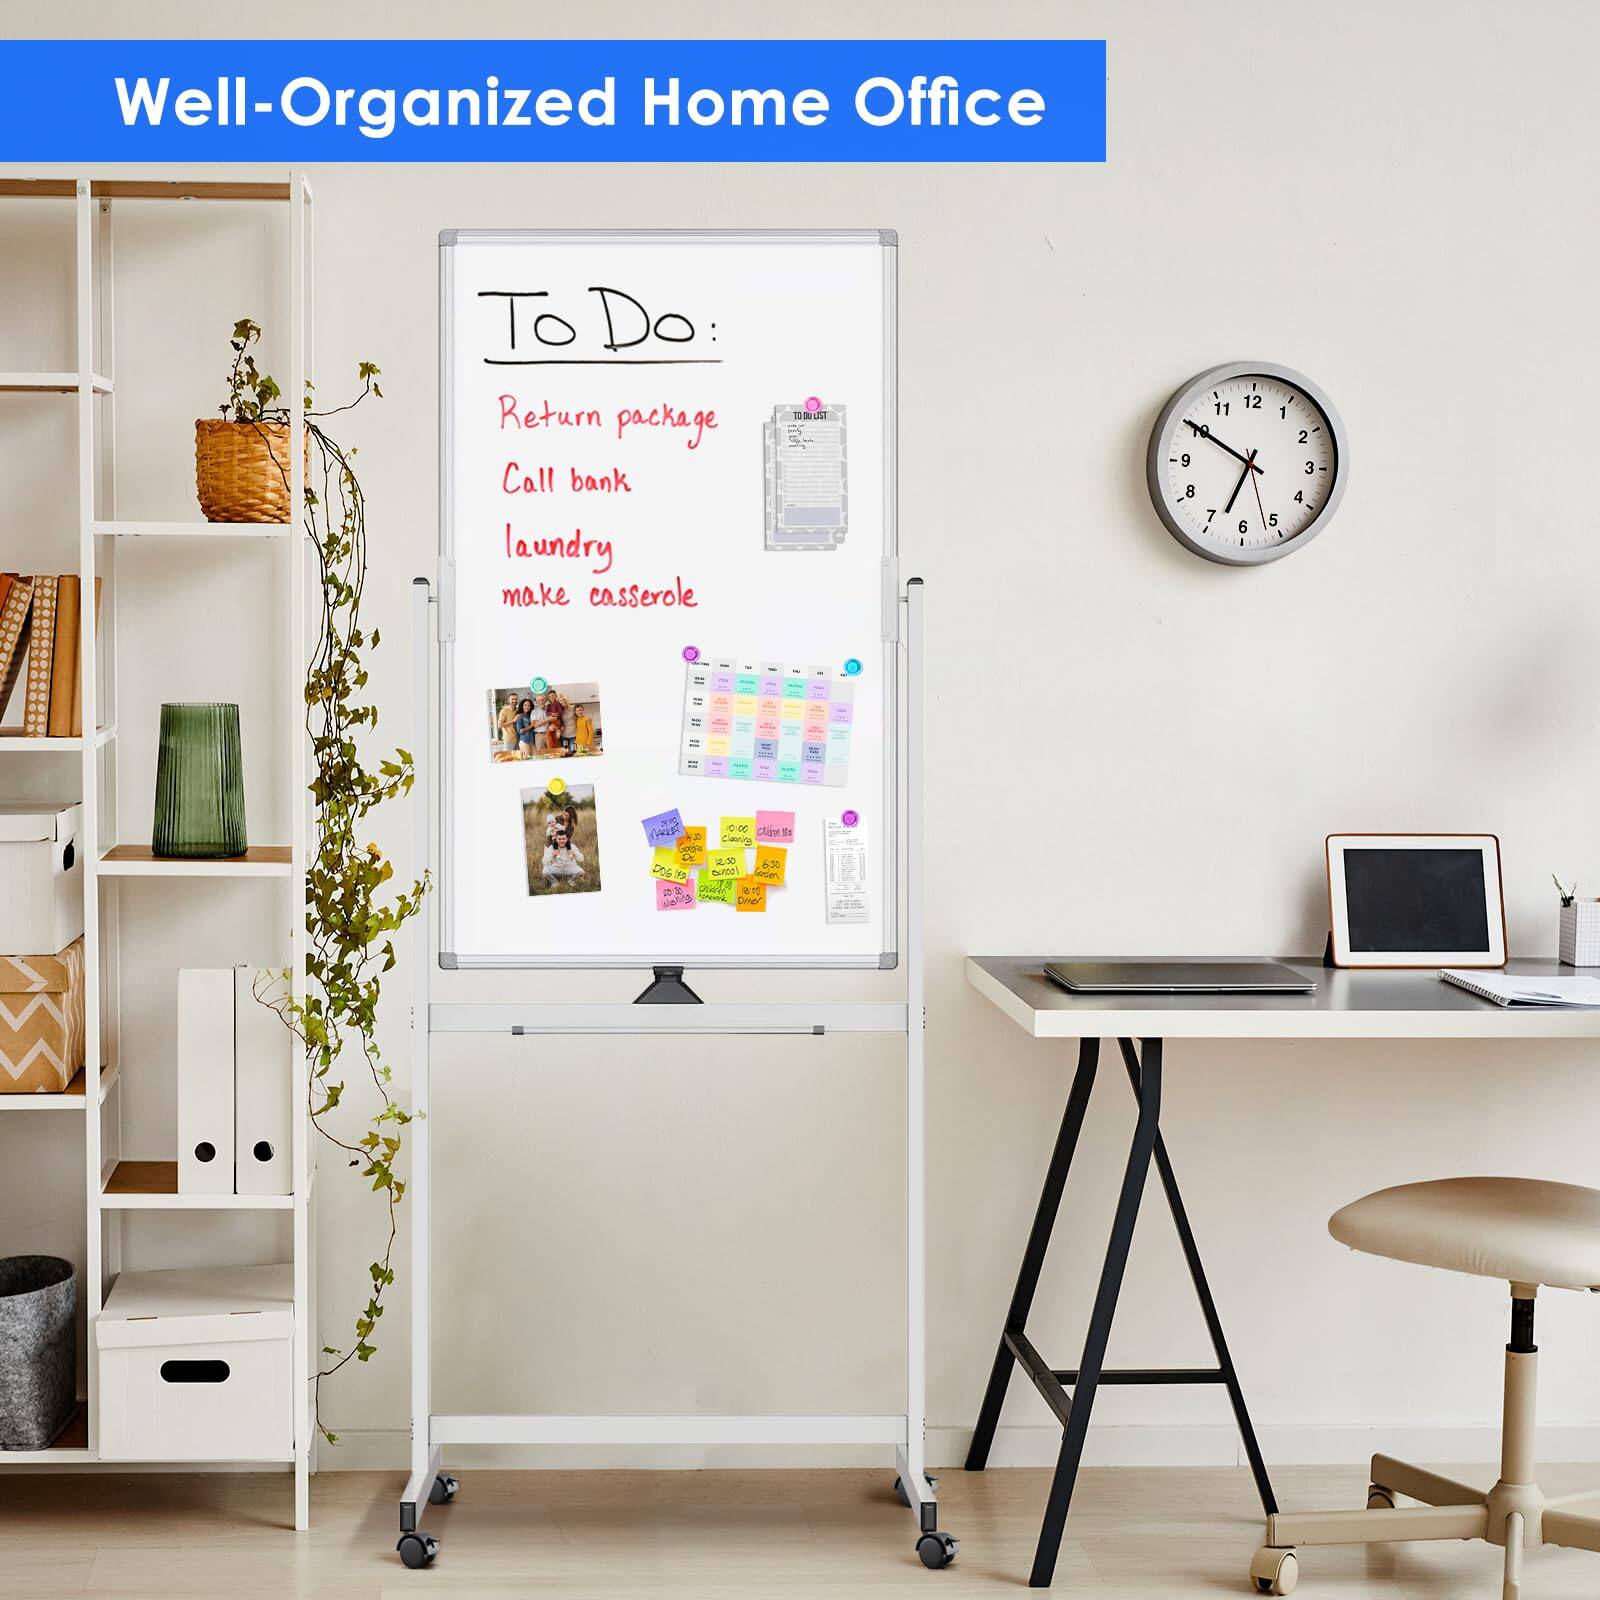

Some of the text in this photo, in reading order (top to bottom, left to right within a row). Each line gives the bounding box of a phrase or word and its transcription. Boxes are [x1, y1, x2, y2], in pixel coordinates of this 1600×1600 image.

[478, 290, 577, 350] To
[1214, 401, 1230, 416] 11
[1244, 394, 1262, 409] 12
[793, 411, 802, 420] TO
[813, 411, 828, 420] LIST
[1279, 405, 1287, 420] 1
[498, 395, 719, 450] Return package
[1297, 430, 1309, 444] 2
[1181, 453, 1191, 468] 9
[1304, 460, 1315, 475] 3
[502, 462, 632, 494] Call bank
[1185, 484, 1196, 499] 8
[1293, 490, 1304, 504] 4
[1206, 509, 1217, 523] 7
[1268, 513, 1278, 527] 5
[1238, 519, 1248, 534] 6
[505, 523, 614, 575] laundry
[502, 576, 698, 609] make casserole
